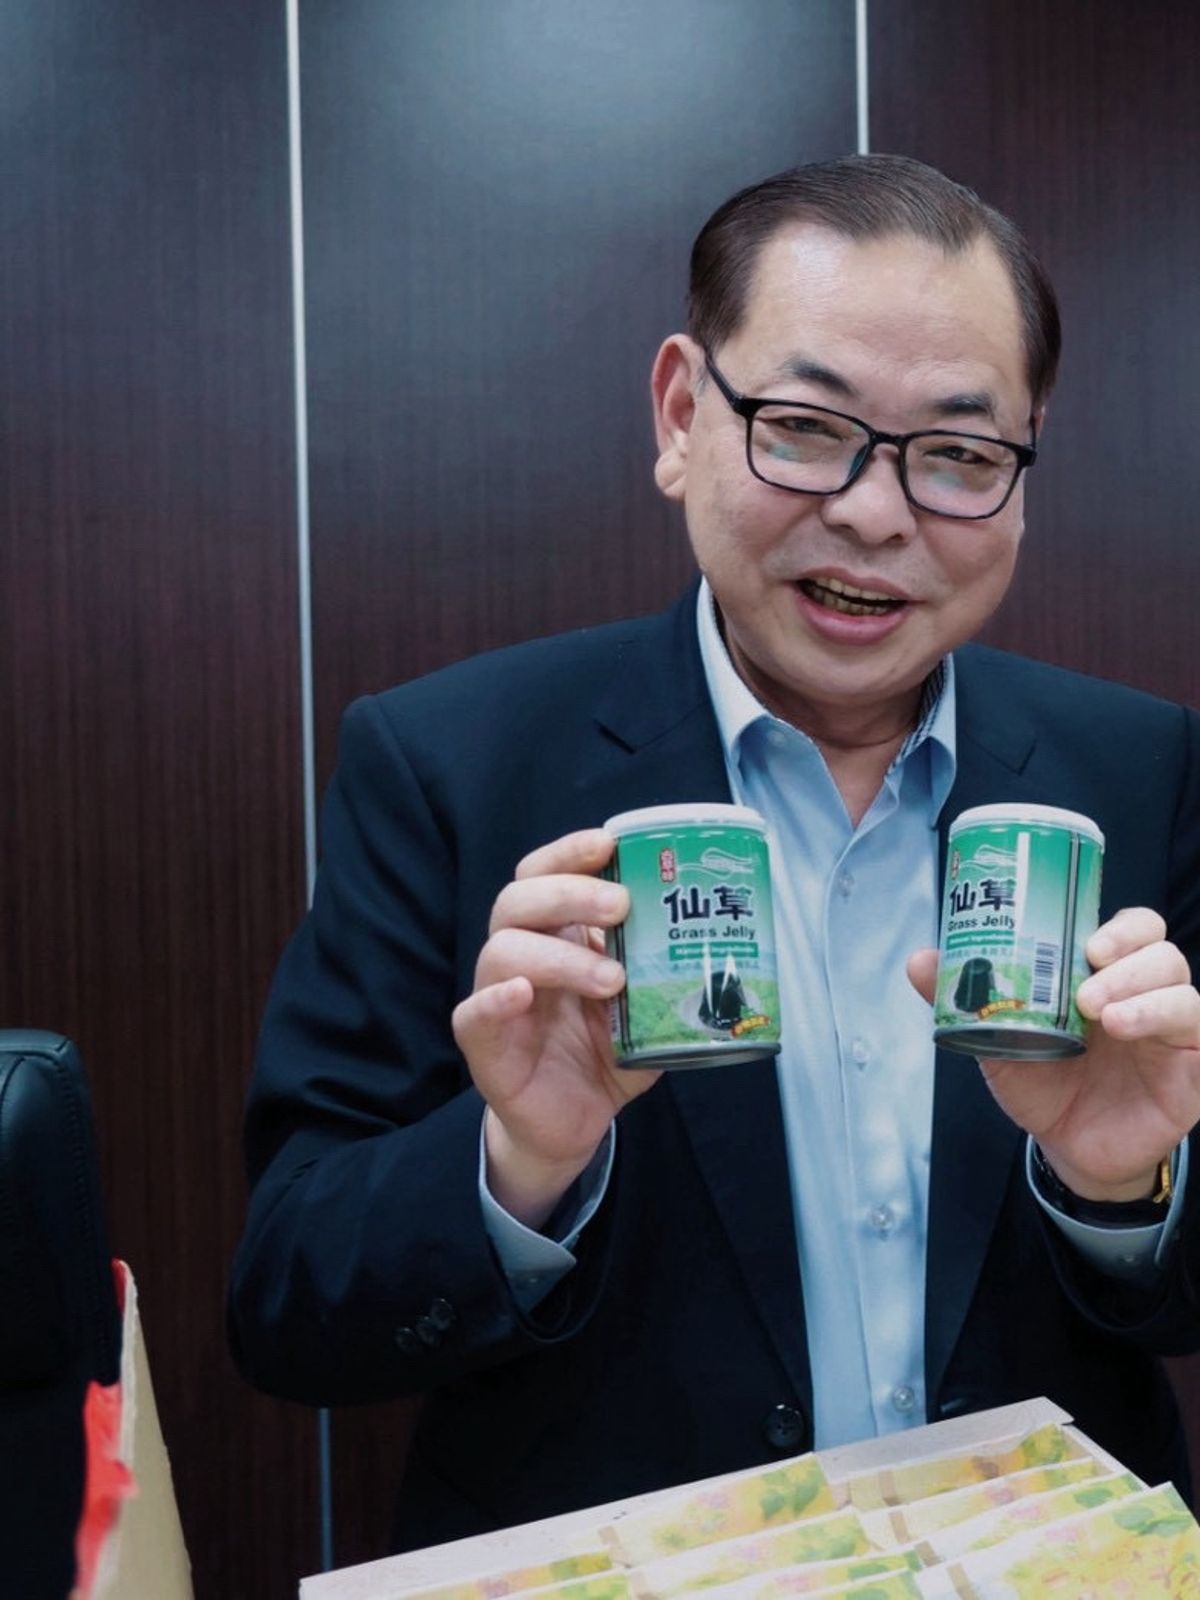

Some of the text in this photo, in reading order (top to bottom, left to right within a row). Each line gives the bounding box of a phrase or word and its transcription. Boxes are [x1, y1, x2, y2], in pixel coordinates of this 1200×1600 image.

[663, 886, 754, 924] 仙草
[949, 879, 1016, 917] 仙草
[722, 925, 756, 940] Jelly
[982, 915, 1015, 929] Jelly
